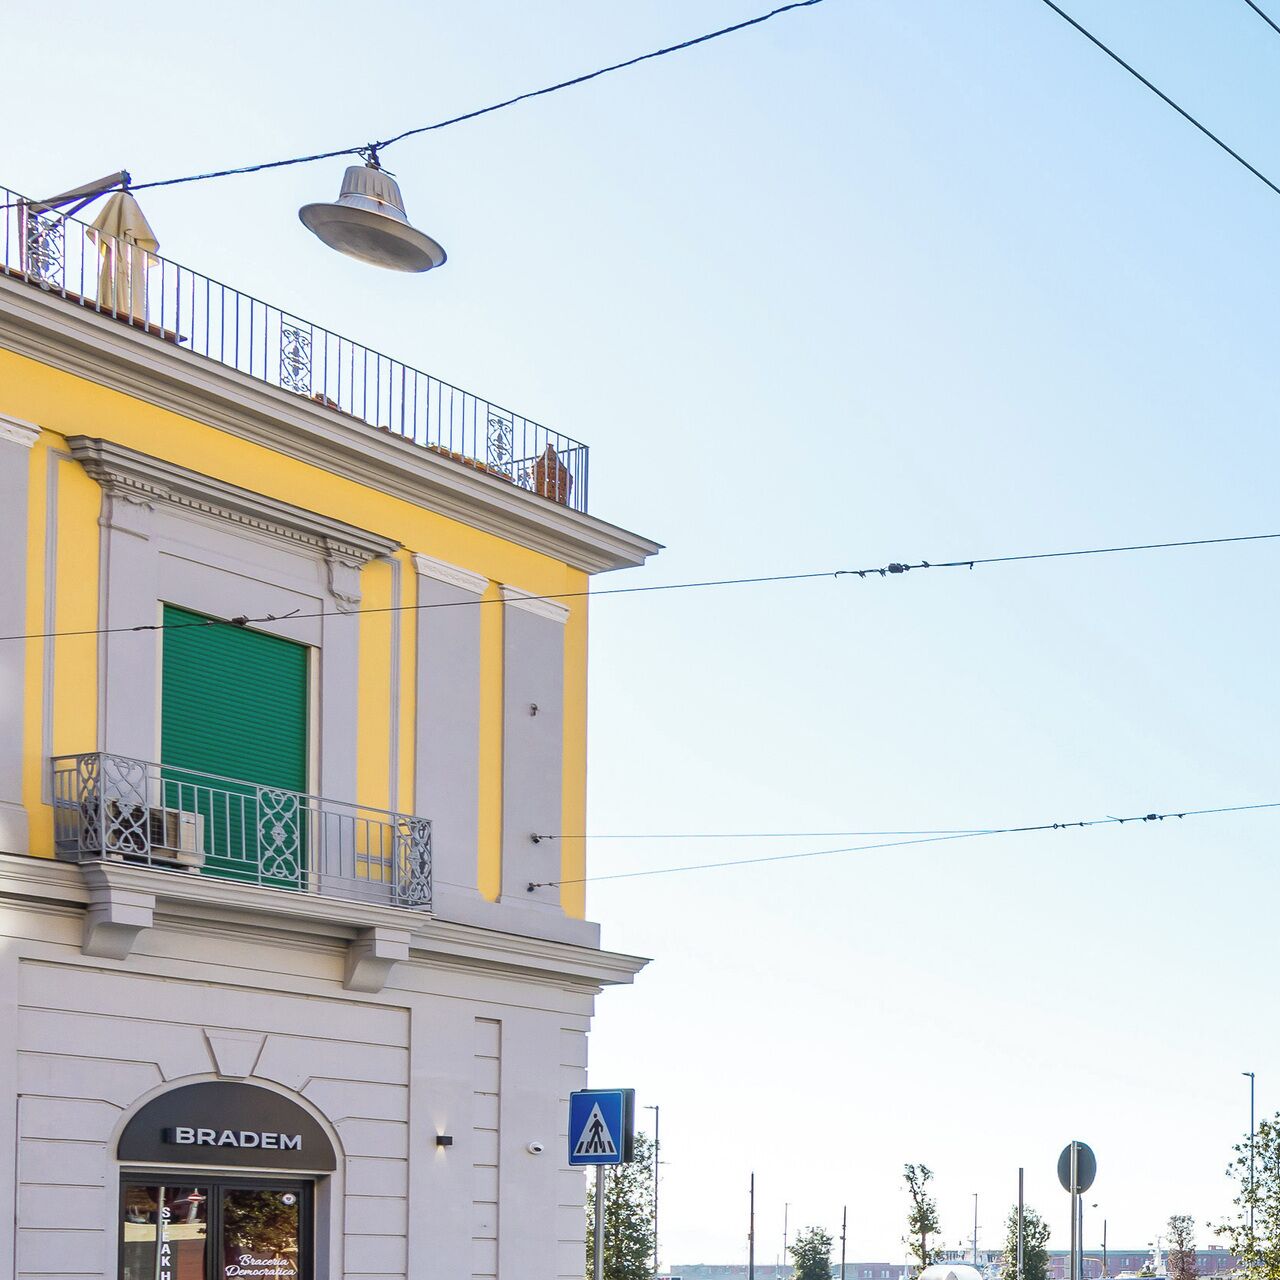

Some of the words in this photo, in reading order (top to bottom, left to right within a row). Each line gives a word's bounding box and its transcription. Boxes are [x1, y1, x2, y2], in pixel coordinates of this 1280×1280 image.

[175, 1126, 302, 1150] BRADEM
[161, 1206, 171, 1267] STEAK
[239, 1254, 290, 1266] Braceria
[225, 1265, 297, 1276] Democratica
